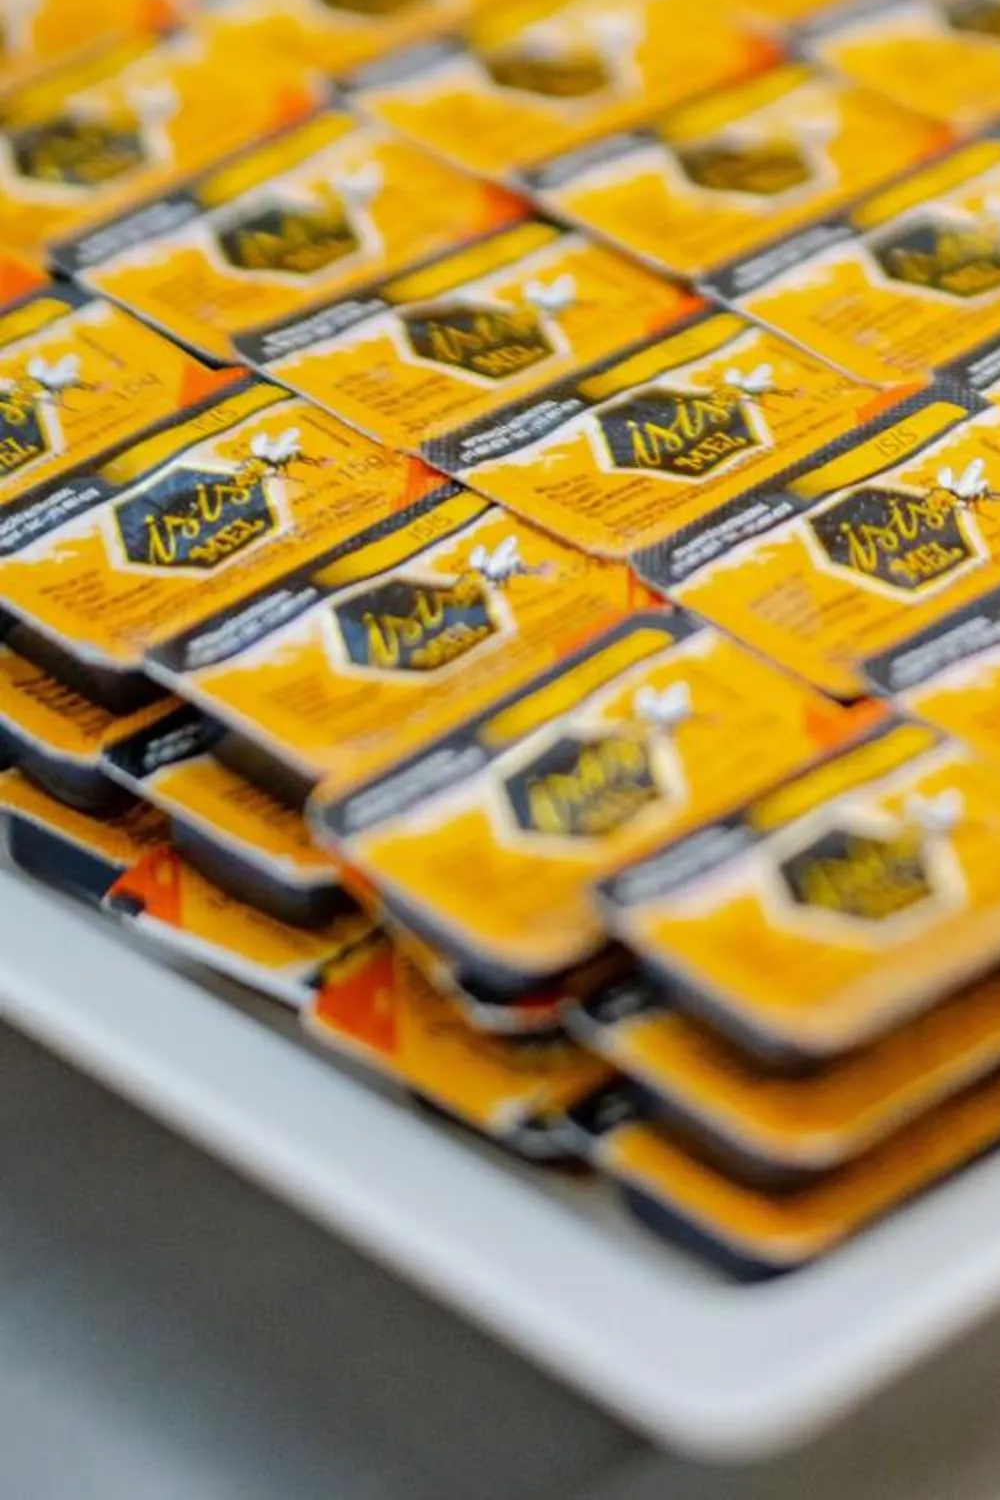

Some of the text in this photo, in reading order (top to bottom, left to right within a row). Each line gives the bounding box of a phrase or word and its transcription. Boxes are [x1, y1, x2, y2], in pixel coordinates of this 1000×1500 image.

[674, 433, 748, 470] MEL
[874, 426, 918, 459] ISIS
[189, 518, 265, 561] MEL
[889, 540, 964, 581] MEL
